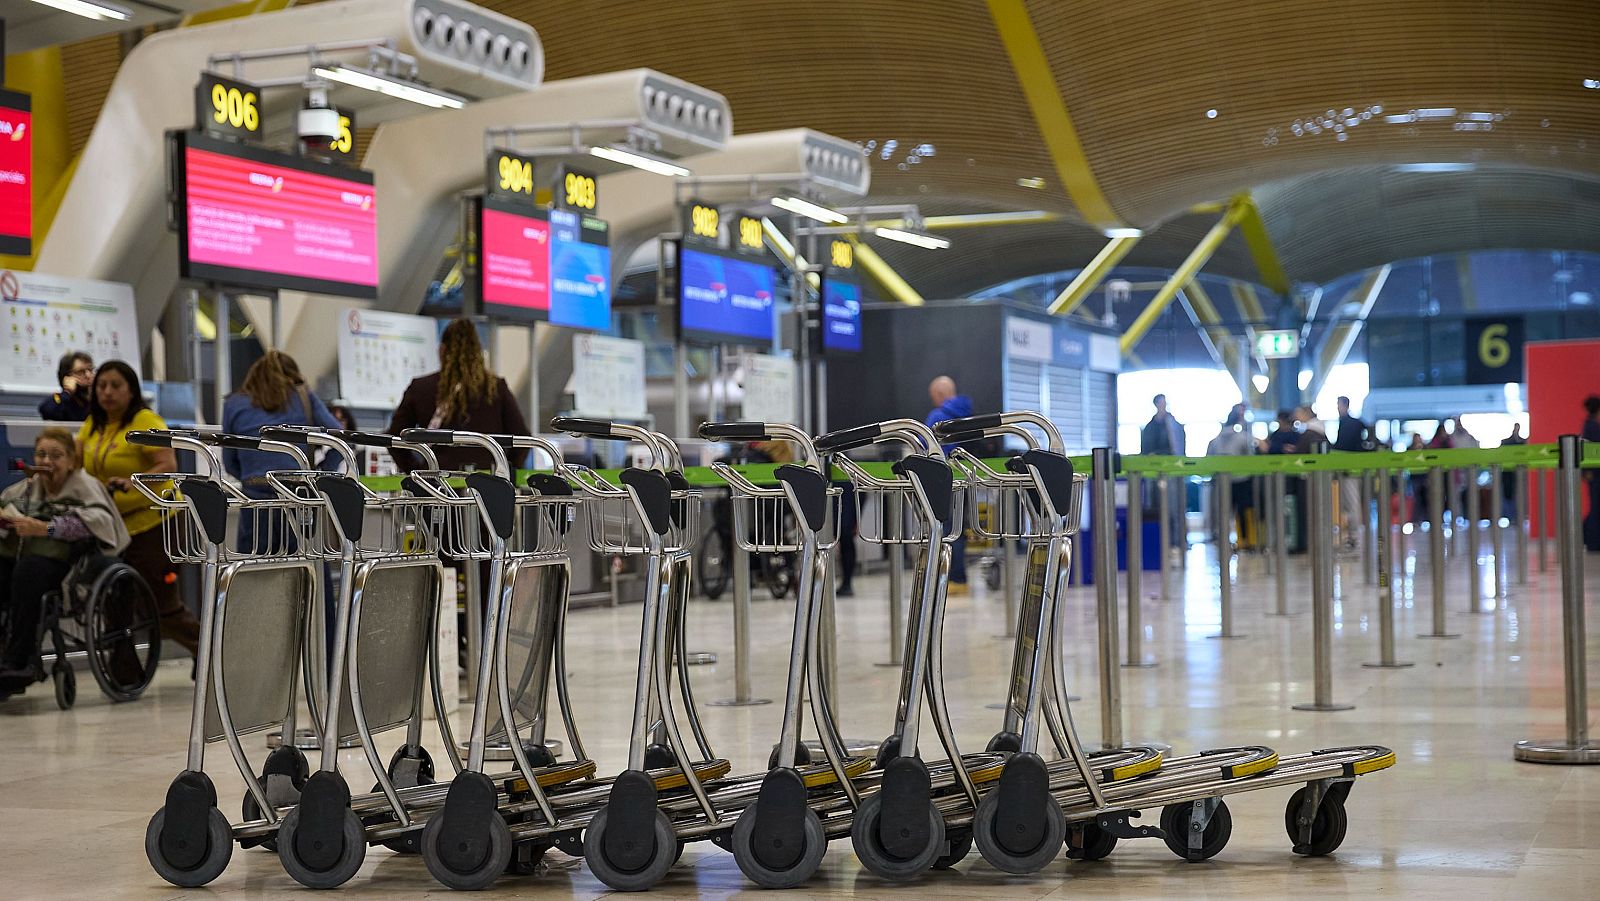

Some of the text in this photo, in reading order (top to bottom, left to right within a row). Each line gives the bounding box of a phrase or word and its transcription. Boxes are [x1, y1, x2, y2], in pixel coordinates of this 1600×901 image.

[211, 84, 259, 131] 906
[498, 156, 534, 195] 904
[565, 172, 596, 209] 903
[1477, 323, 1511, 368] 6
